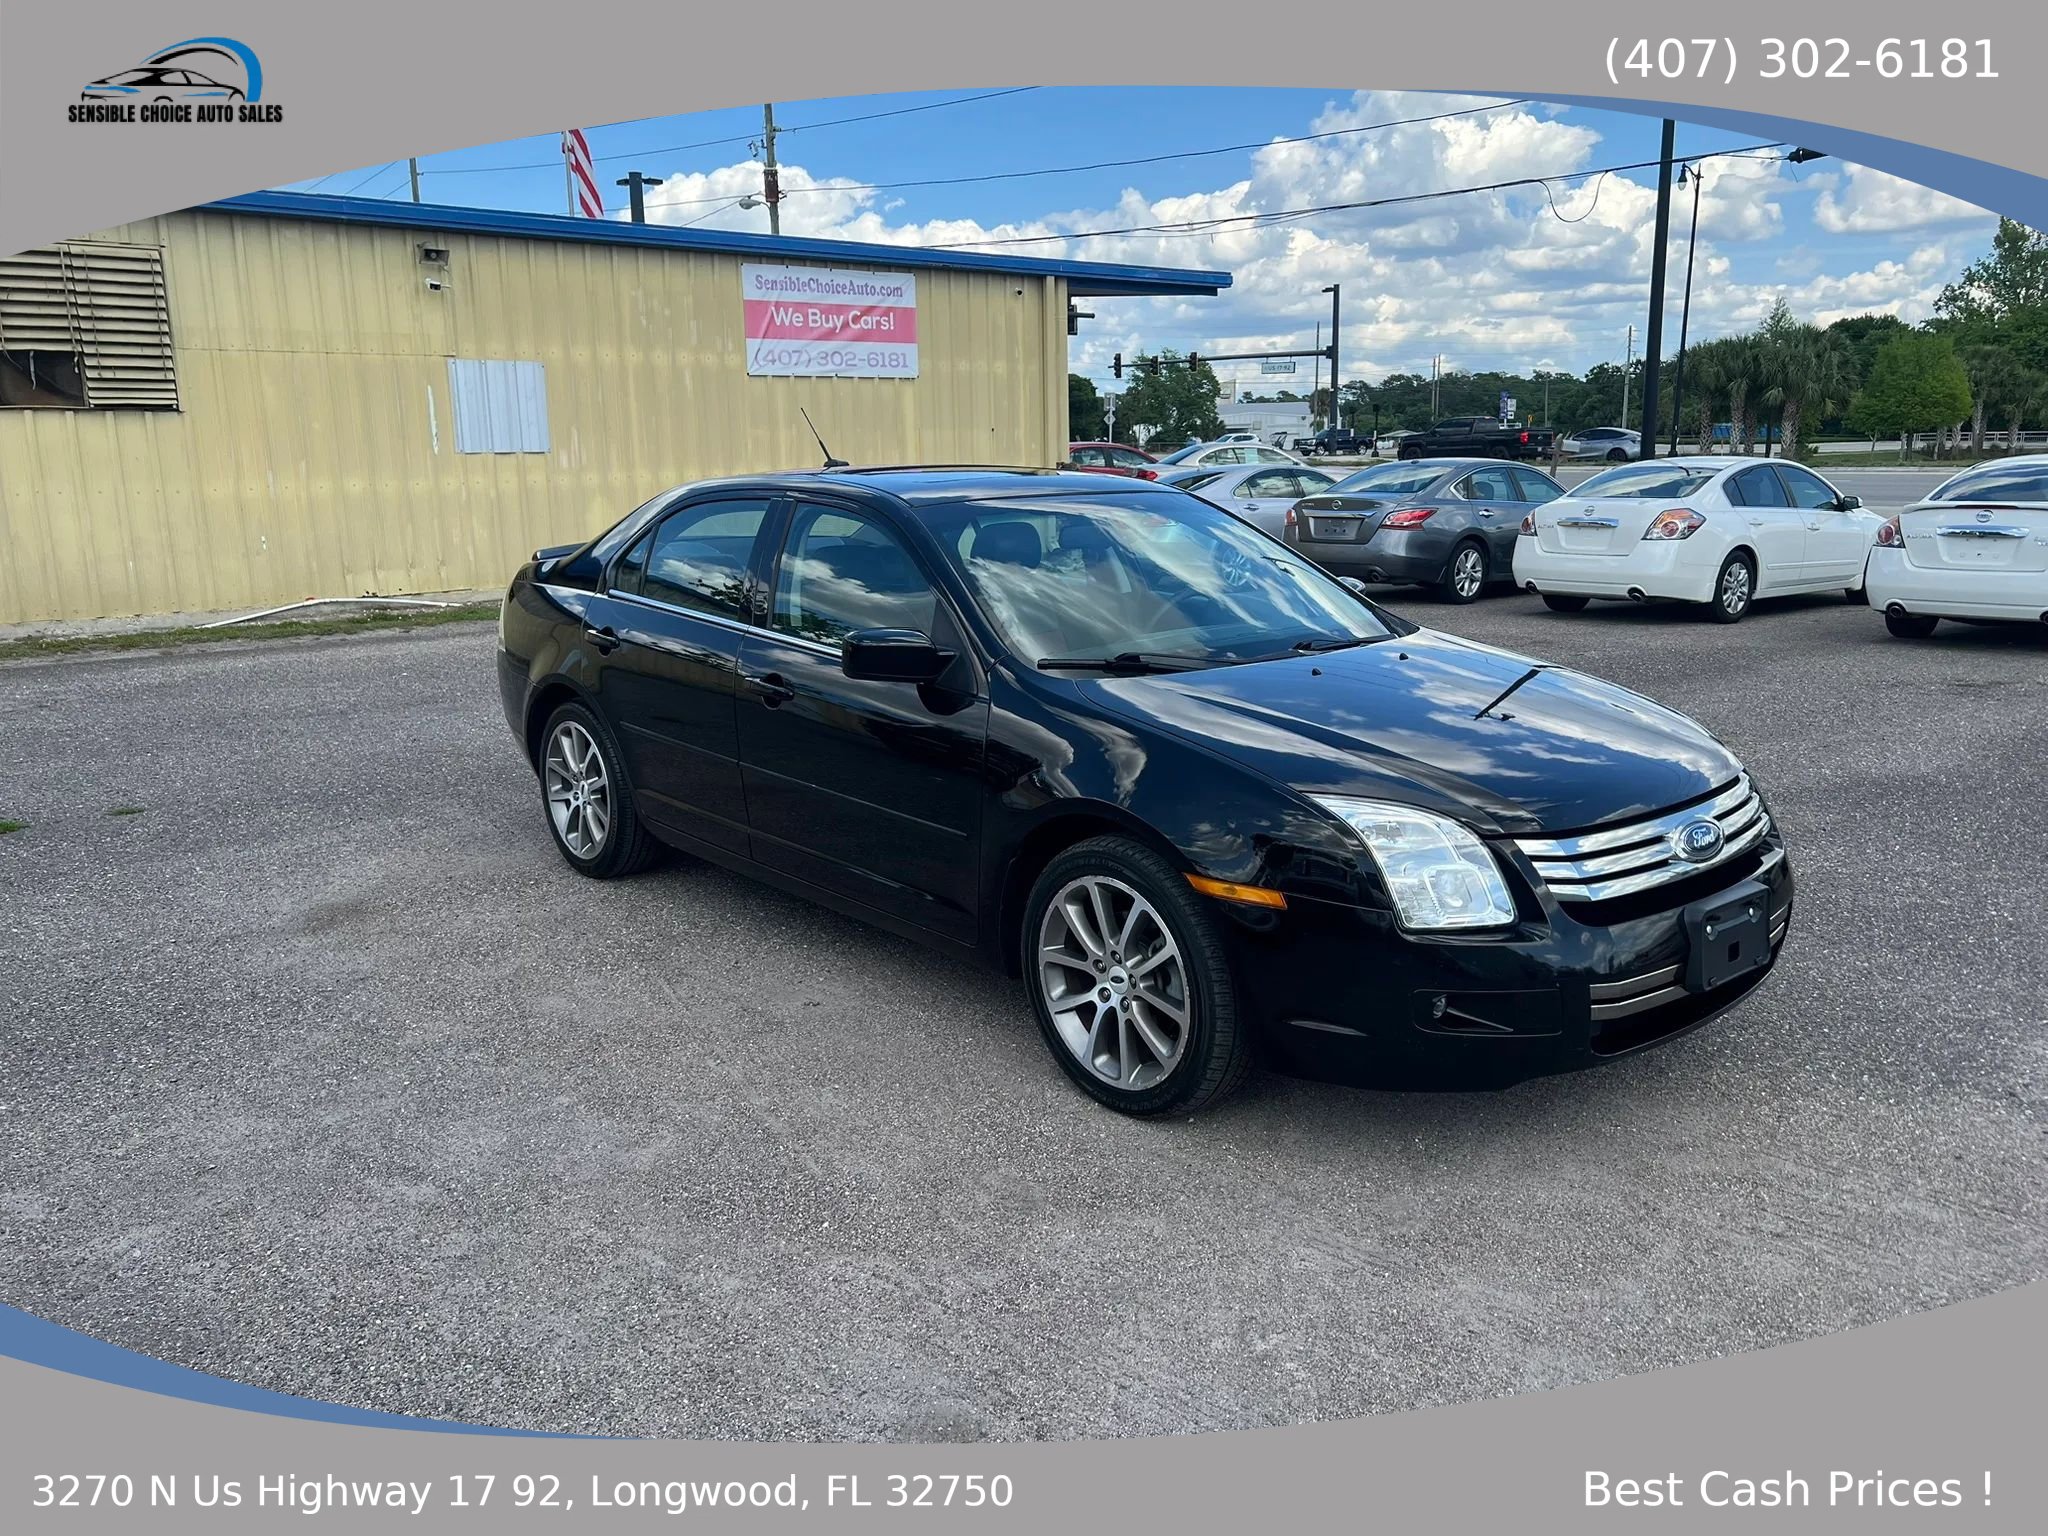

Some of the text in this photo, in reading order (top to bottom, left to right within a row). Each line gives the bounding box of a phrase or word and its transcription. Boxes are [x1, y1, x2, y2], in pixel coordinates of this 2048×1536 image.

[755, 274, 903, 298] SensibleChoiceAuto.com
[771, 306, 894, 333] We Buy Cars!
[754, 349, 909, 369] (407) 302-6181
[1692, 827, 1715, 848] Ford
